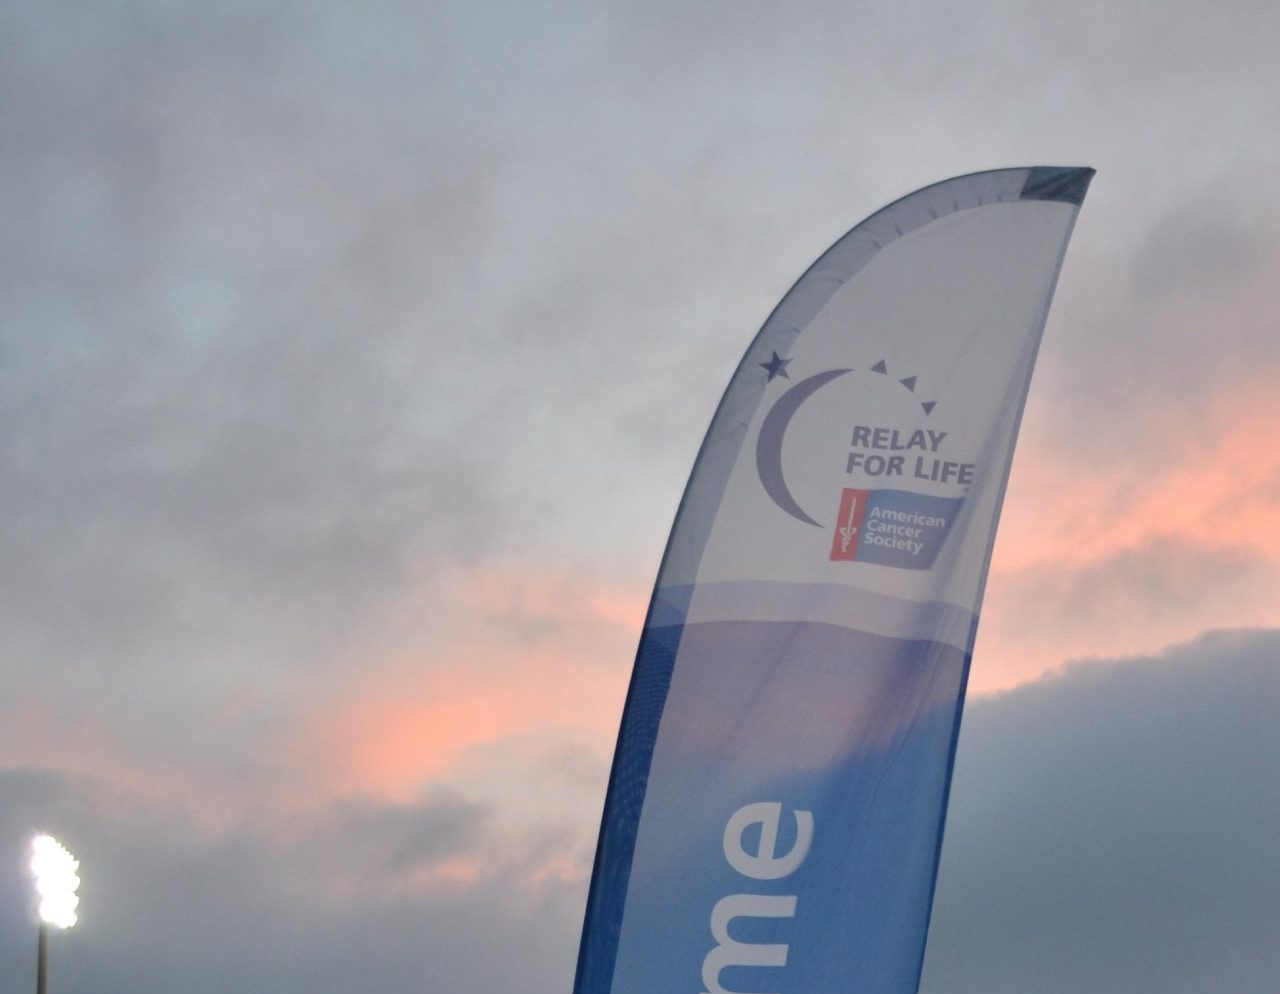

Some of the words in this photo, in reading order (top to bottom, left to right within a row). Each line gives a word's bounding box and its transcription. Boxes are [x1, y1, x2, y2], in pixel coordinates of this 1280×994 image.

[851, 425, 948, 453] RELAY
[846, 452, 905, 477] FOR
[914, 455, 976, 485] LIFE
[869, 506, 946, 528] American
[867, 519, 923, 539] Cancer
[863, 532, 924, 555] Society
